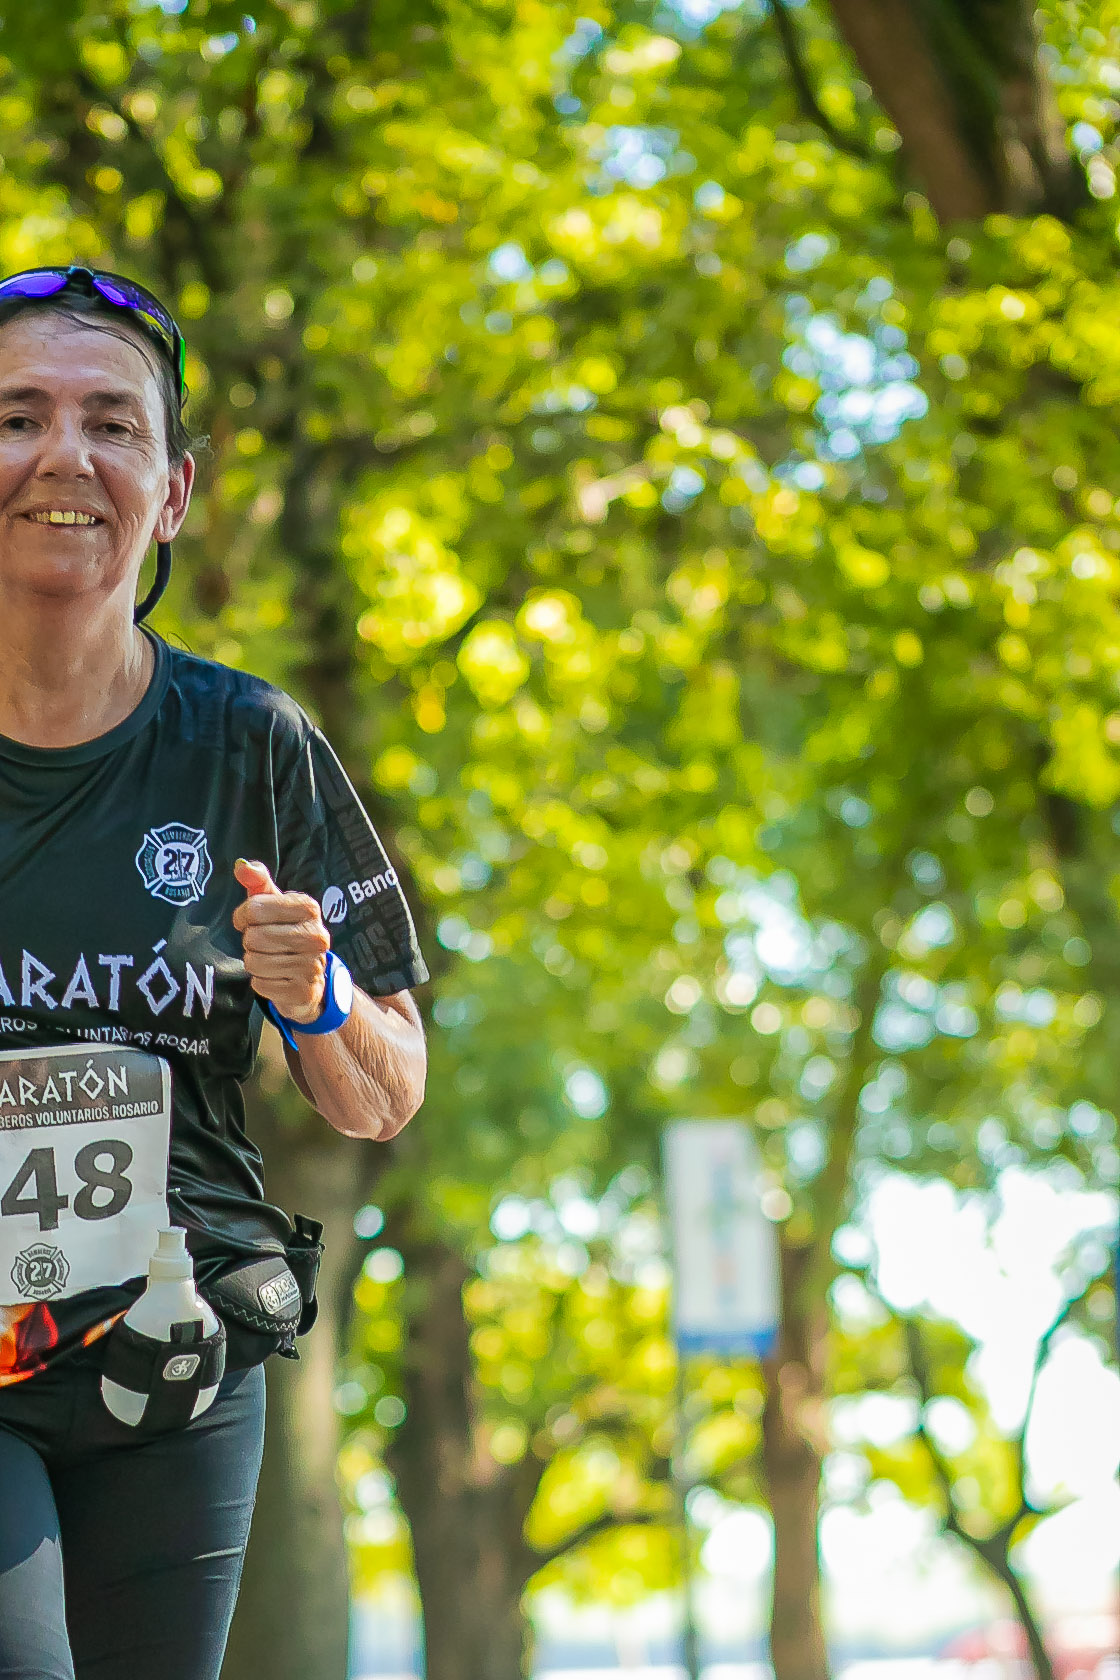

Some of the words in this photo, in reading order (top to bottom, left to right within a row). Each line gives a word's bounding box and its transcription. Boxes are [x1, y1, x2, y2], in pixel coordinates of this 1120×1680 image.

[163, 847, 195, 876] 27
[347, 867, 397, 905] Banc
[35, 1107, 109, 1127] VOLUNTARIOS
[112, 1100, 159, 1118] ROSARIO
[29, 1261, 53, 1282] 27
